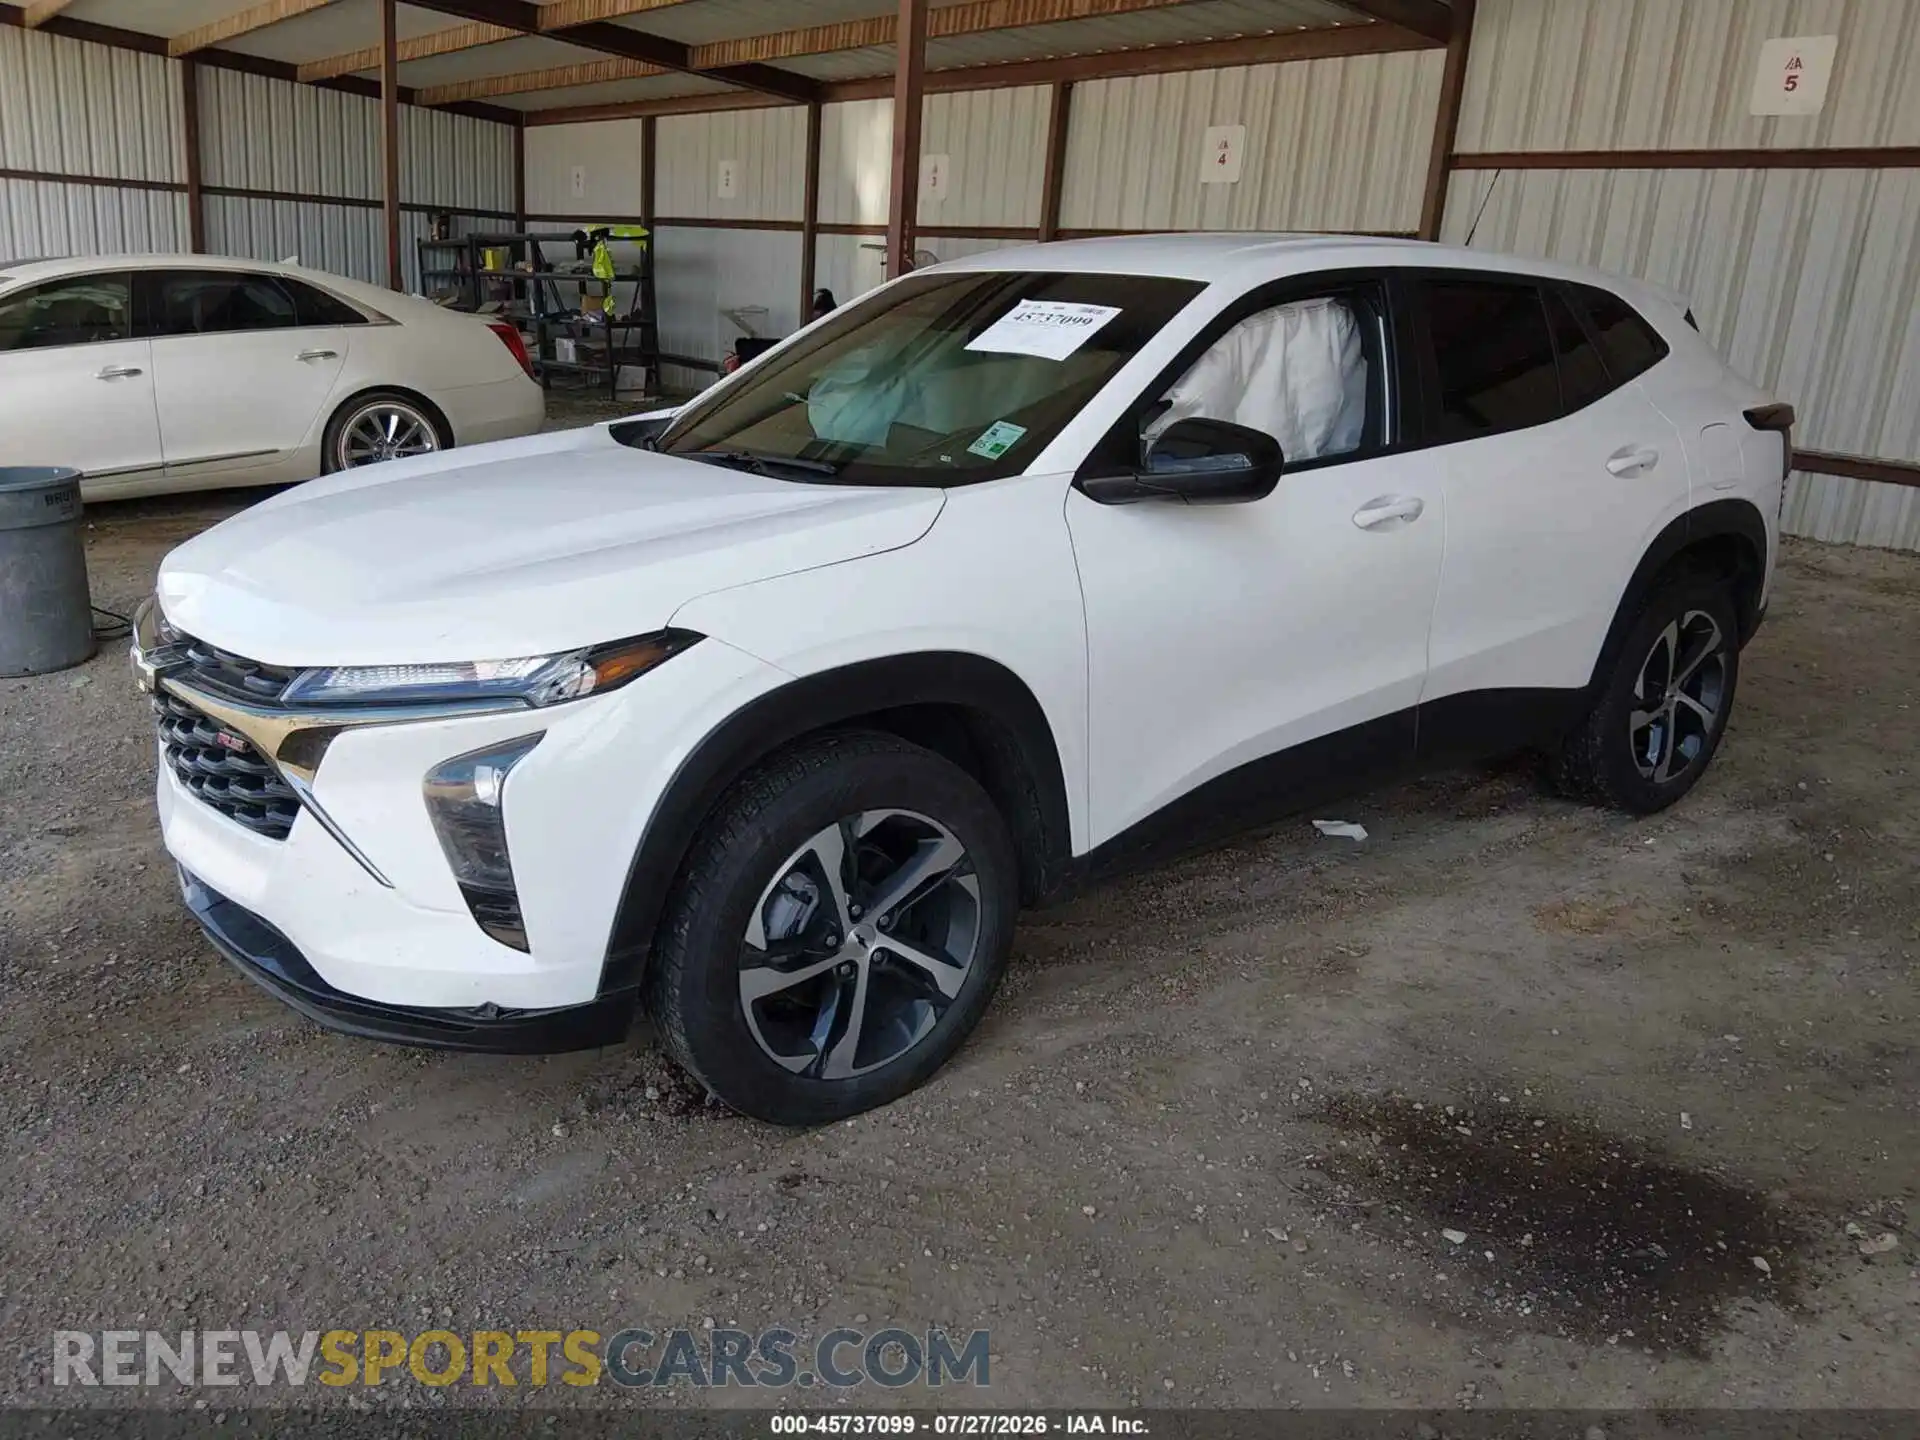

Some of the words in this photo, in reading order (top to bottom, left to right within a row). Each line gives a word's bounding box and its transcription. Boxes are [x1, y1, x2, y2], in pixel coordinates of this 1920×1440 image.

[1784, 75, 1799, 92] 5
[1218, 152, 1227, 166] 4
[1013, 311, 1093, 326] 45737099
